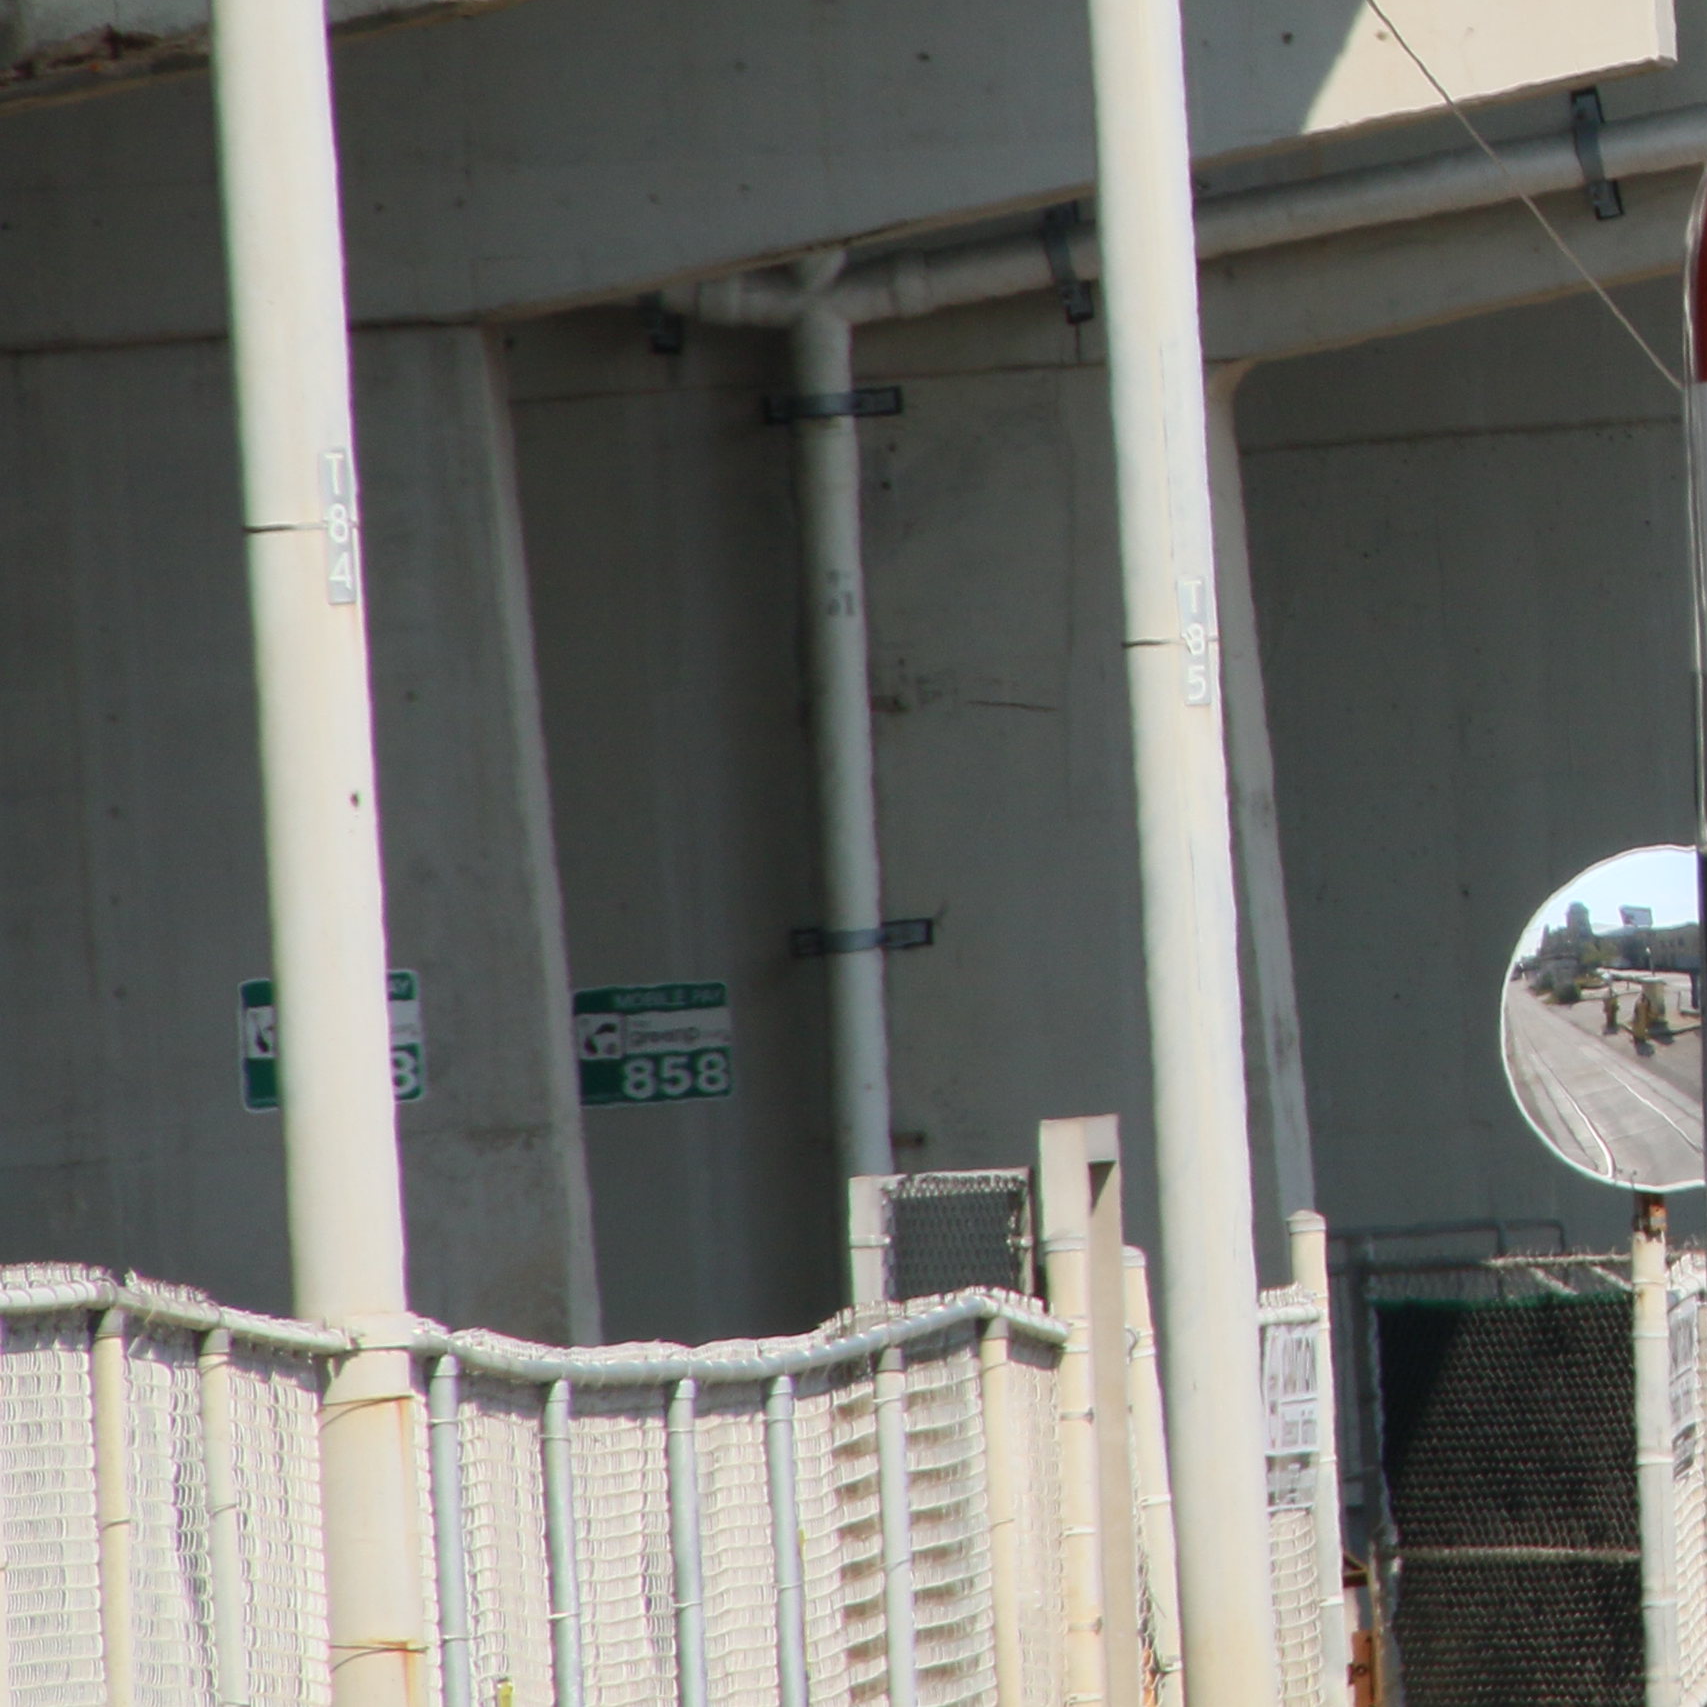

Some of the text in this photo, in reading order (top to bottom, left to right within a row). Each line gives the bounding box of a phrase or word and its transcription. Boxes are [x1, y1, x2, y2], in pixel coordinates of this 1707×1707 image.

[324, 453, 352, 589] T84
[1183, 580, 1206, 700] T85
[623, 1051, 729, 1100] 858
